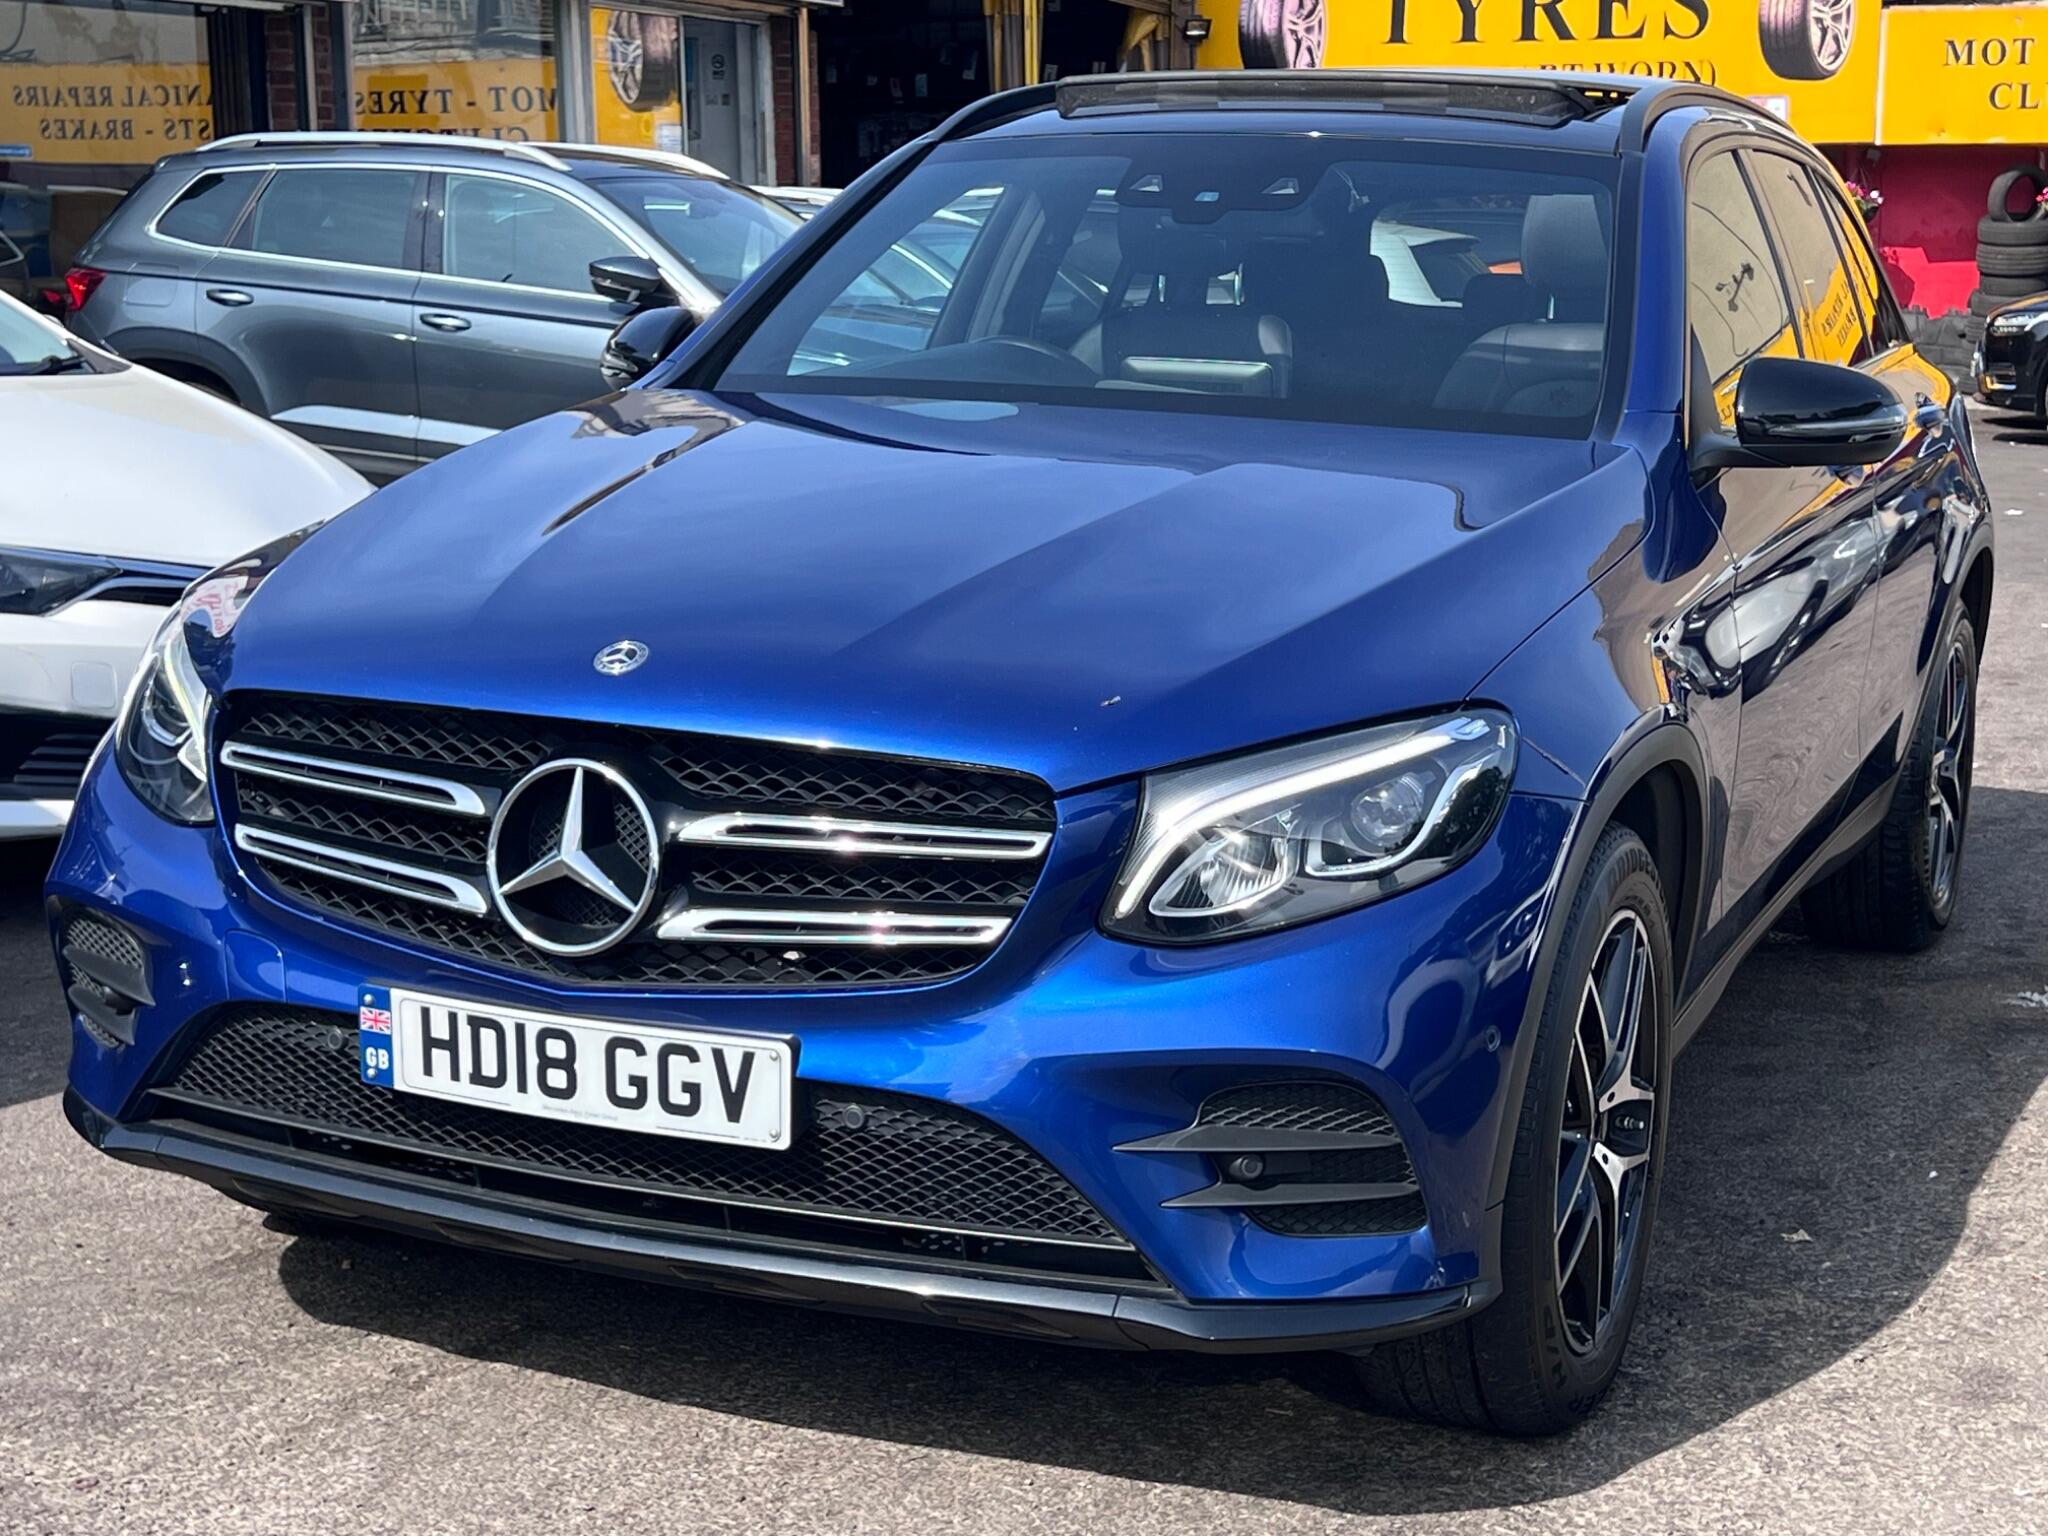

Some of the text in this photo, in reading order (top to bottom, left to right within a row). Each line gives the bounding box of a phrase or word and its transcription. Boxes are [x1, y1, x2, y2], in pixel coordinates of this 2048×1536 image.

[1943, 38, 2035, 66] MOT
[1989, 82, 2048, 110] CL
[366, 1046, 390, 1070] GB
[420, 1006, 755, 1124] HD18 GGV
